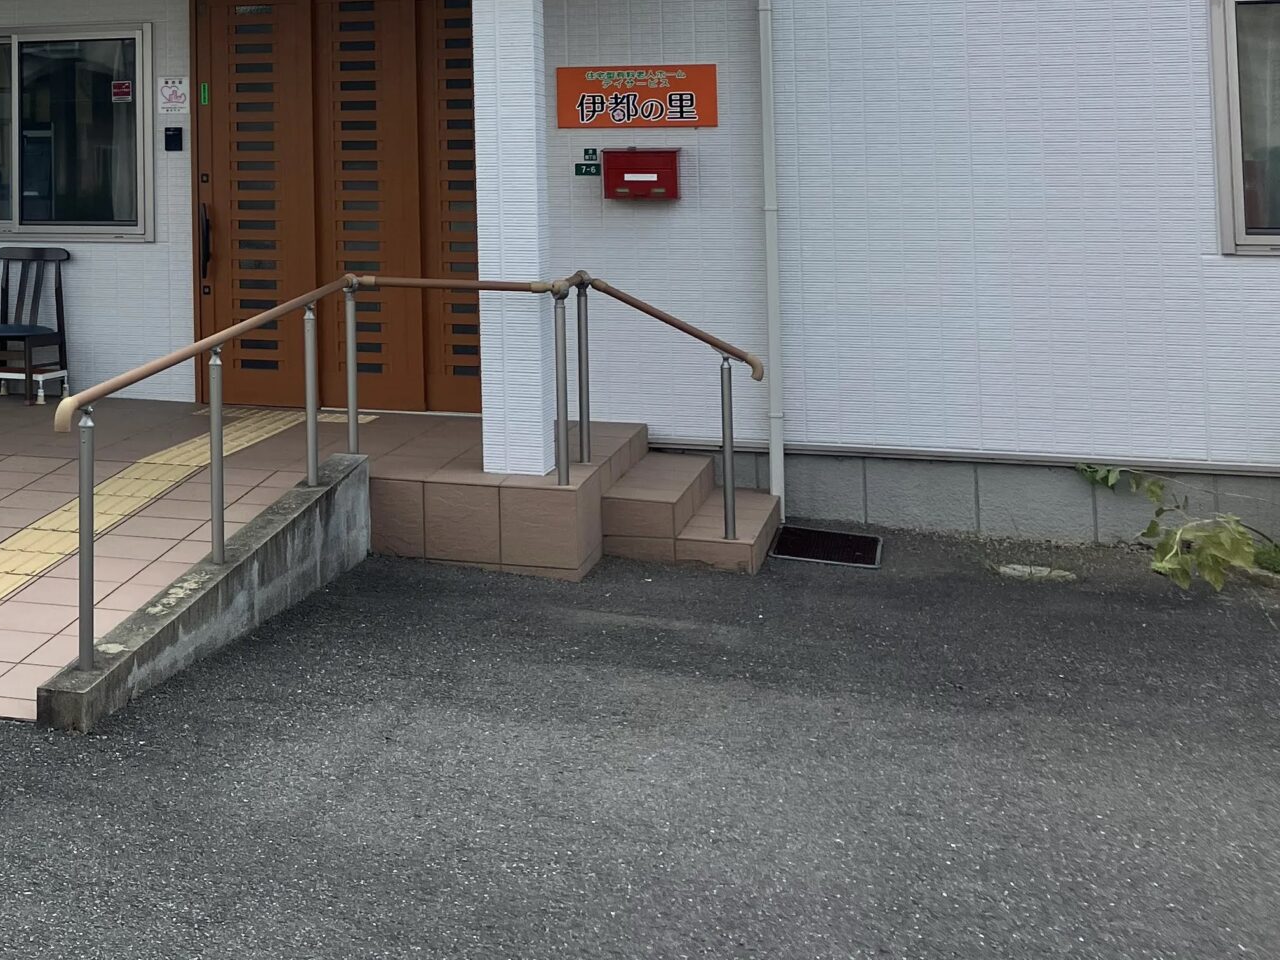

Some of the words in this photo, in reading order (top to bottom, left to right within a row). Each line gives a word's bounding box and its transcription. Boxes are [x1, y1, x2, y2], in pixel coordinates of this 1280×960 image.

[576, 92, 698, 123] 伊都の里
[581, 165, 596, 174] 7-6
